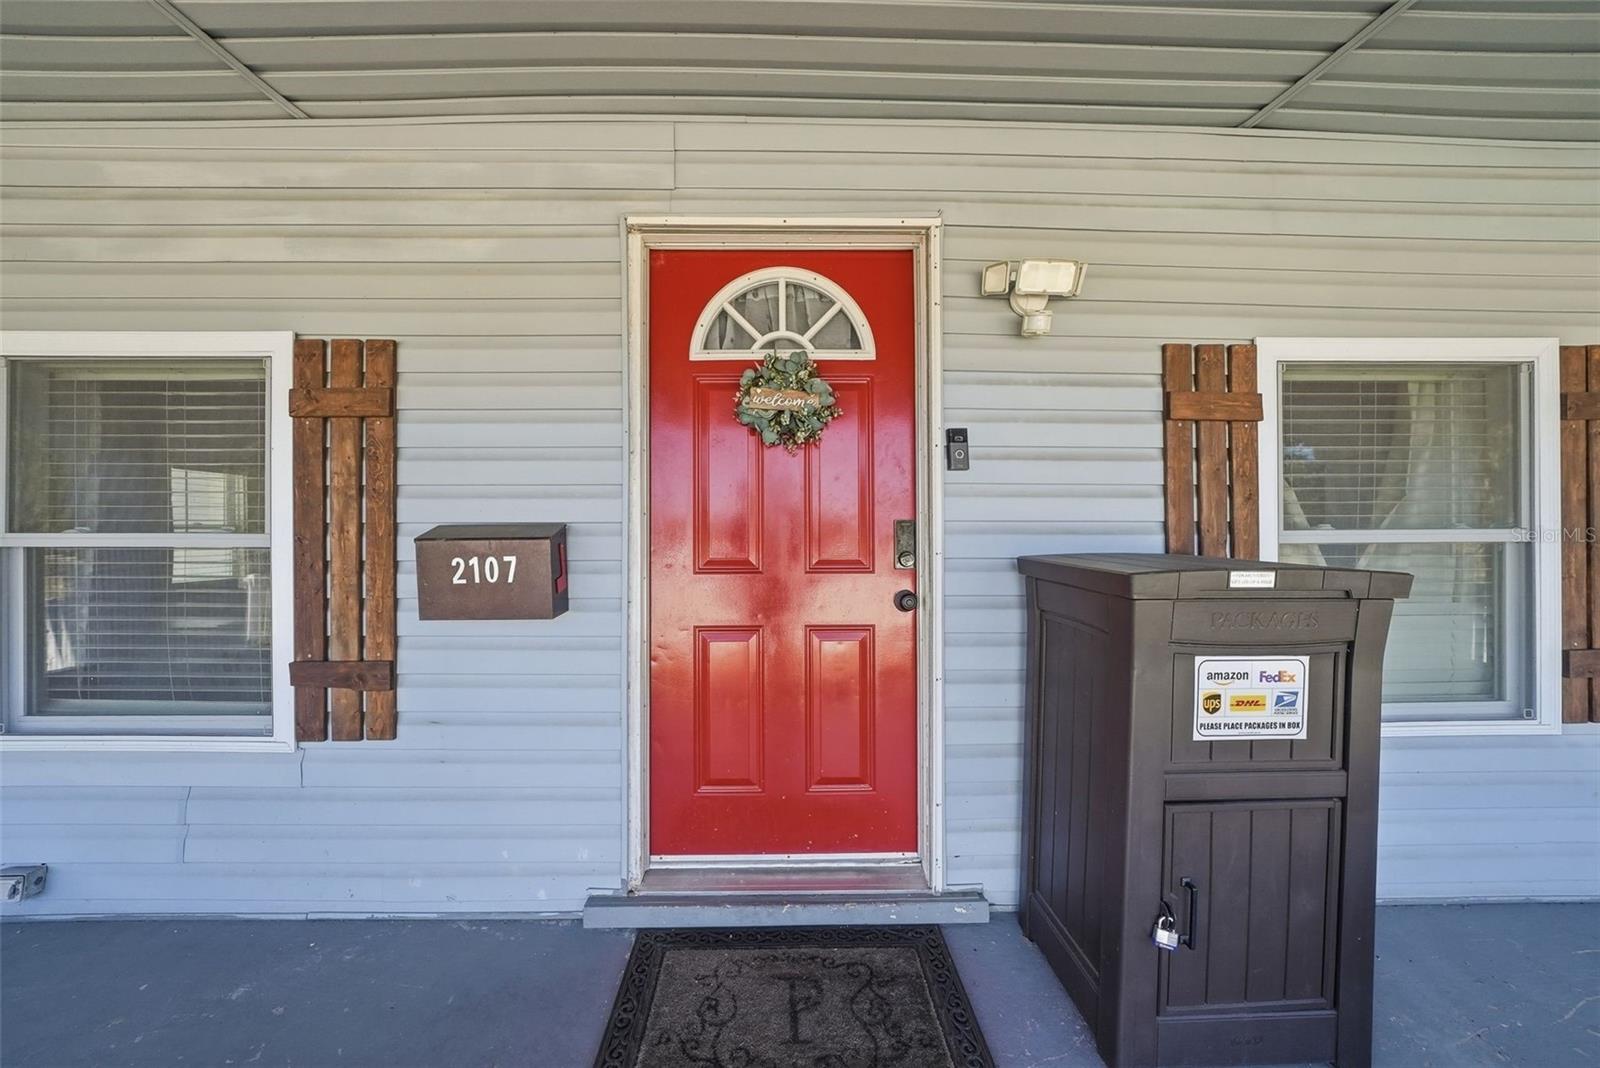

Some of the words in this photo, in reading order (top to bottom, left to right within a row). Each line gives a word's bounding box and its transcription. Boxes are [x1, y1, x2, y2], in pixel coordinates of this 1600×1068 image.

[451, 555, 517, 585] 2107
[1208, 610, 1320, 631] PACKAGES
[1206, 671, 1249, 681] amazon
[1259, 670, 1297, 683] FedEx
[1204, 698, 1221, 712] ups
[1199, 722, 1222, 731] PLEASE
[1223, 722, 1243, 731] PLACE
[1244, 721, 1278, 730] PACKAGES
[1279, 721, 1285, 730] IN
[1287, 721, 1300, 730] BOX
